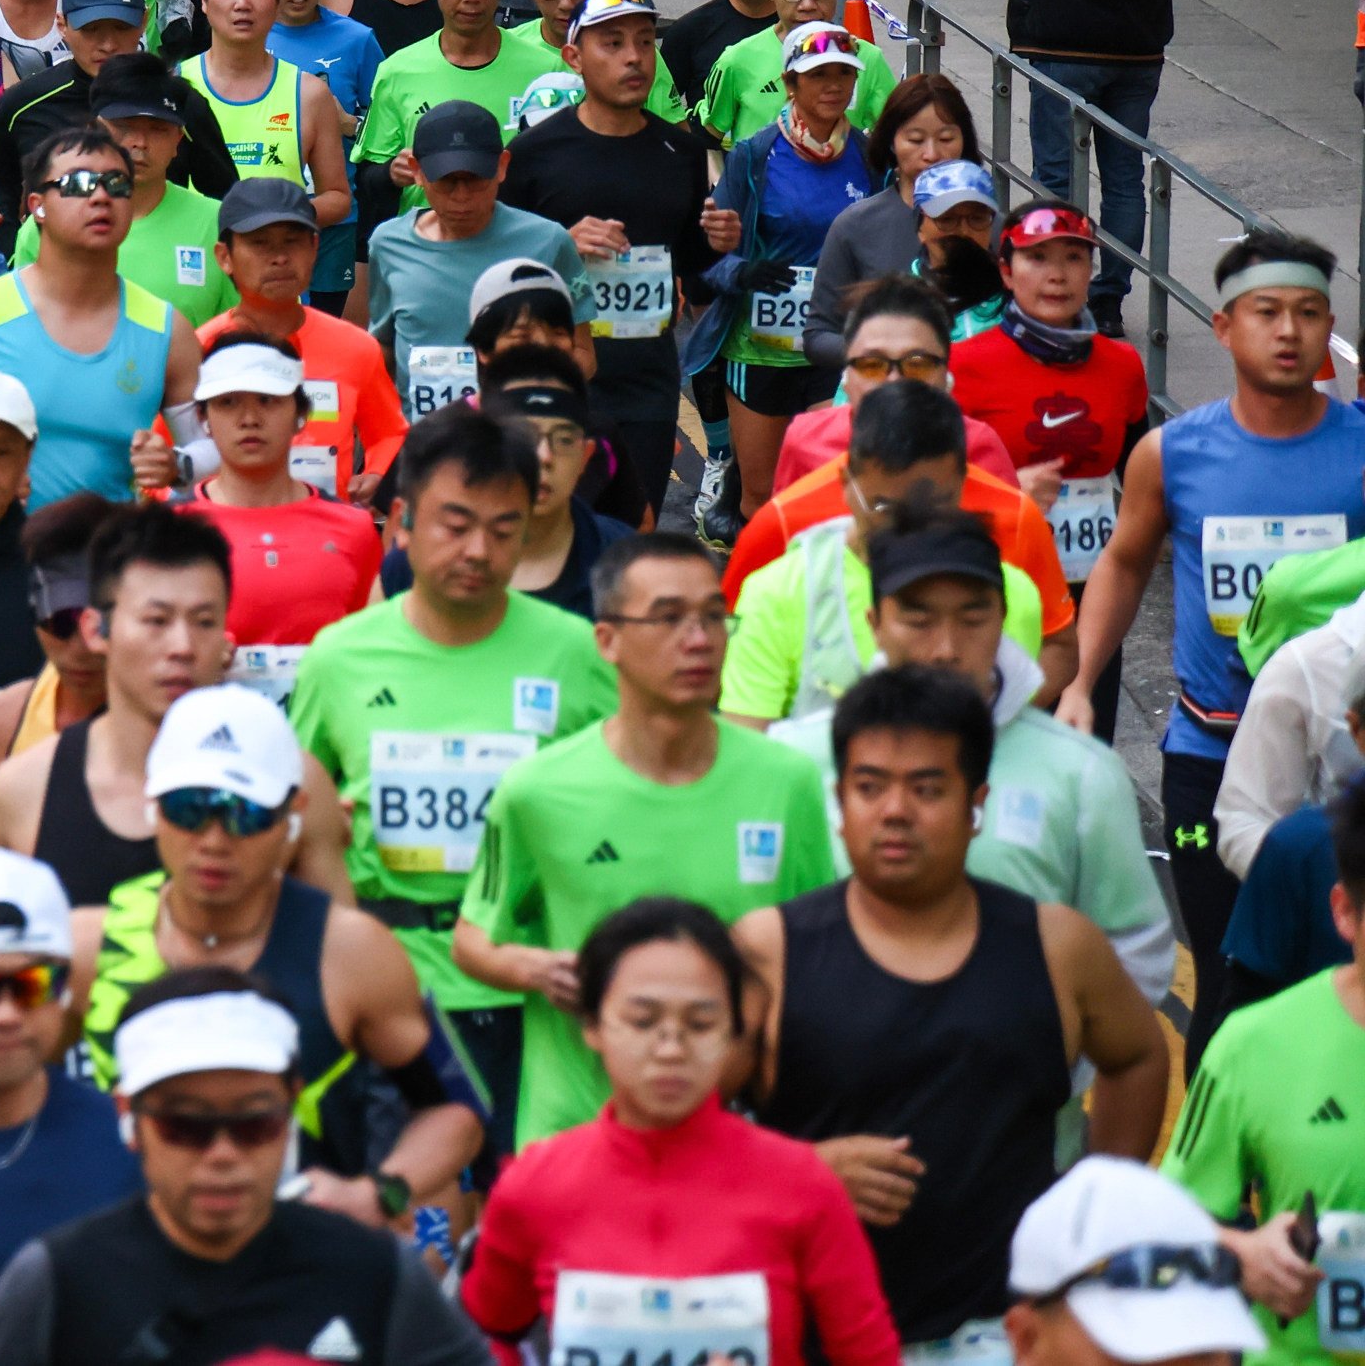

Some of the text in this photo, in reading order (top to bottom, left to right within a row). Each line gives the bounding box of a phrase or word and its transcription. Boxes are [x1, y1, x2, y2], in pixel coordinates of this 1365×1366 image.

[596, 281, 666, 312] 3921
[1051, 517, 1112, 553] 186
[1211, 564, 1269, 602] B0
